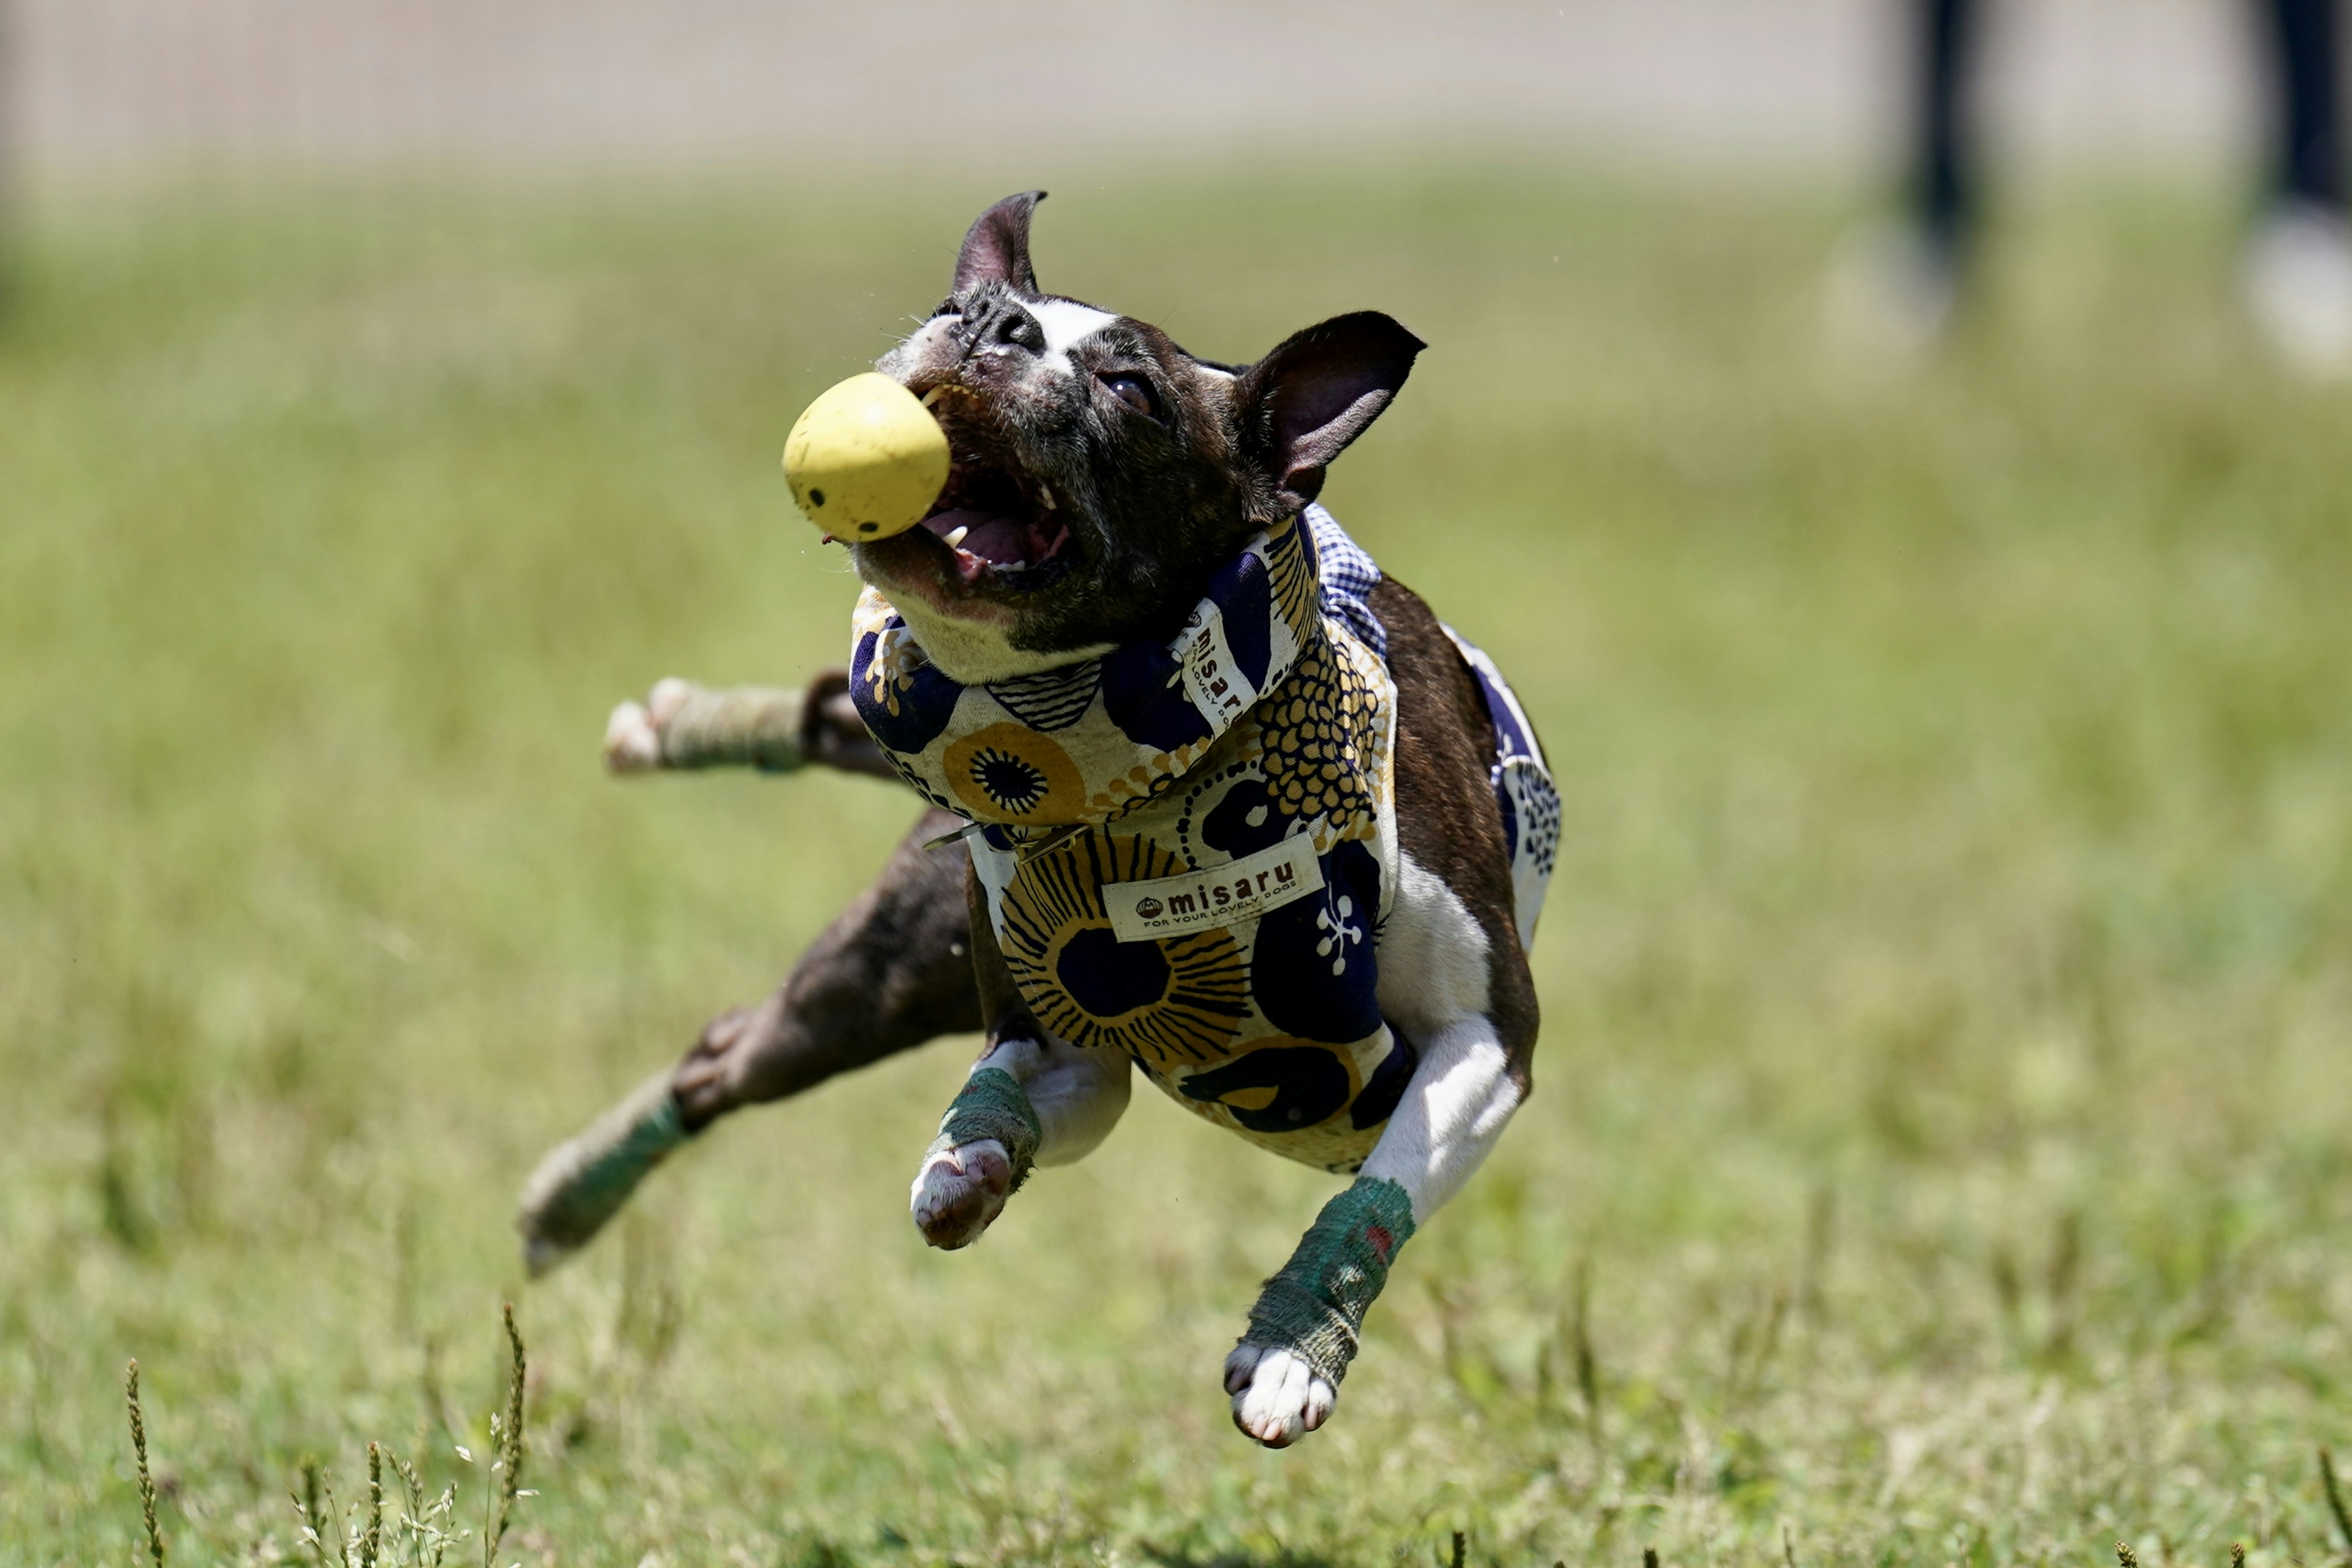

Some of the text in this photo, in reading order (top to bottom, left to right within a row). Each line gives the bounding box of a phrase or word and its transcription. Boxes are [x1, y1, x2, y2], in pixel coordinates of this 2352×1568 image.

[1192, 666, 1218, 705] LOVELY
[1197, 627, 1244, 724] misar
[1168, 861, 1294, 915] misaru
[1173, 913, 1207, 923] YOUR
[1211, 896, 1259, 916] LOVELY
[1265, 880, 1297, 899] DOGS
